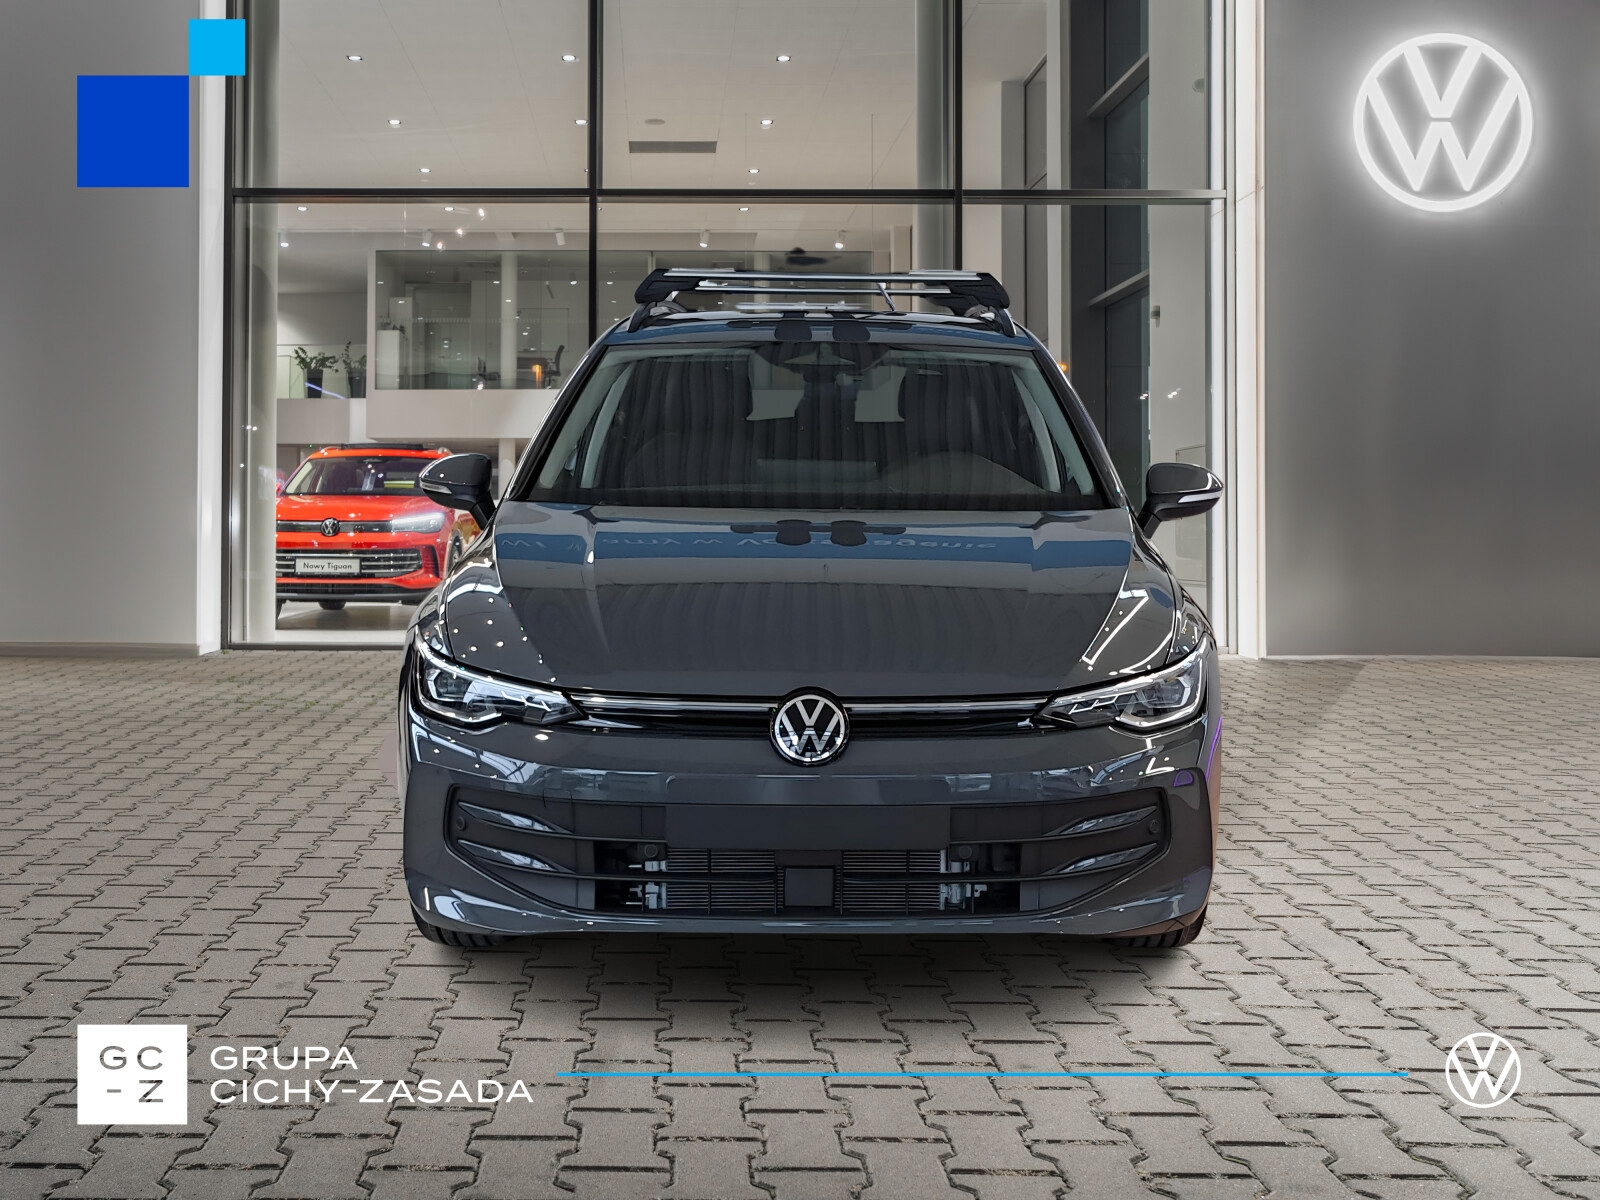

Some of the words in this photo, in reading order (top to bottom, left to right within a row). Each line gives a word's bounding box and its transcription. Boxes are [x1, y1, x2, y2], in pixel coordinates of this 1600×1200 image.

[1358, 40, 1527, 194] VW
[303, 562, 325, 571] Nowy
[327, 562, 353, 571] Tiguan
[778, 697, 842, 758] VW
